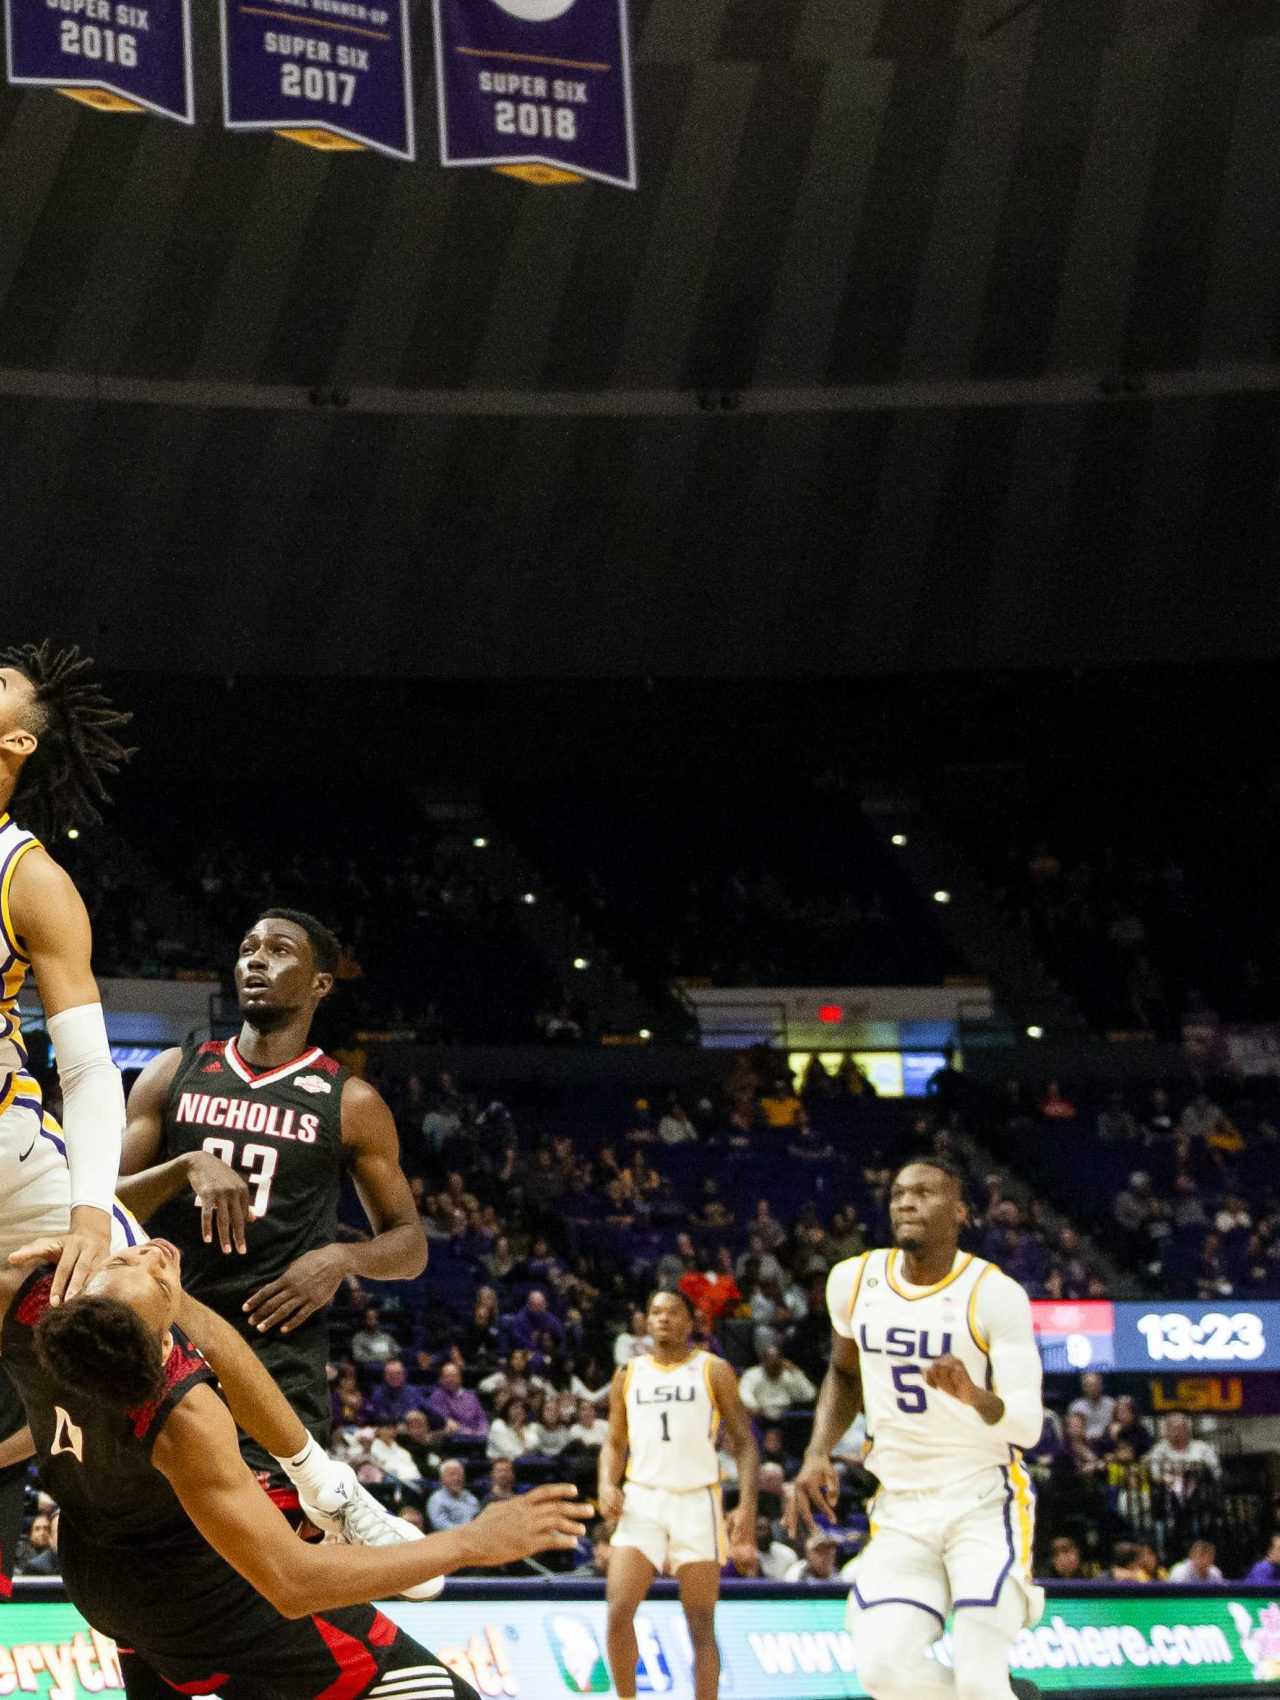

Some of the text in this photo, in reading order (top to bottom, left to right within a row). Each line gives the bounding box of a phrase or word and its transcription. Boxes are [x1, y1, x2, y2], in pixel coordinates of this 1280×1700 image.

[116, 4, 149, 31] SIX
[60, 19, 138, 67] 2016
[264, 32, 369, 71] SUPER SIX
[281, 63, 356, 106] 2017
[479, 71, 588, 103] SUPER SIX
[495, 101, 576, 141] 2018
[176, 1093, 319, 1143] NICHOLLS
[860, 1324, 952, 1359] LSU
[1137, 1312, 1266, 1361] 13:23
[636, 1385, 695, 1404] LSU
[891, 1364, 927, 1414] 5
[1151, 1378, 1244, 1409] LSU
[660, 1410, 671, 1442] 1
